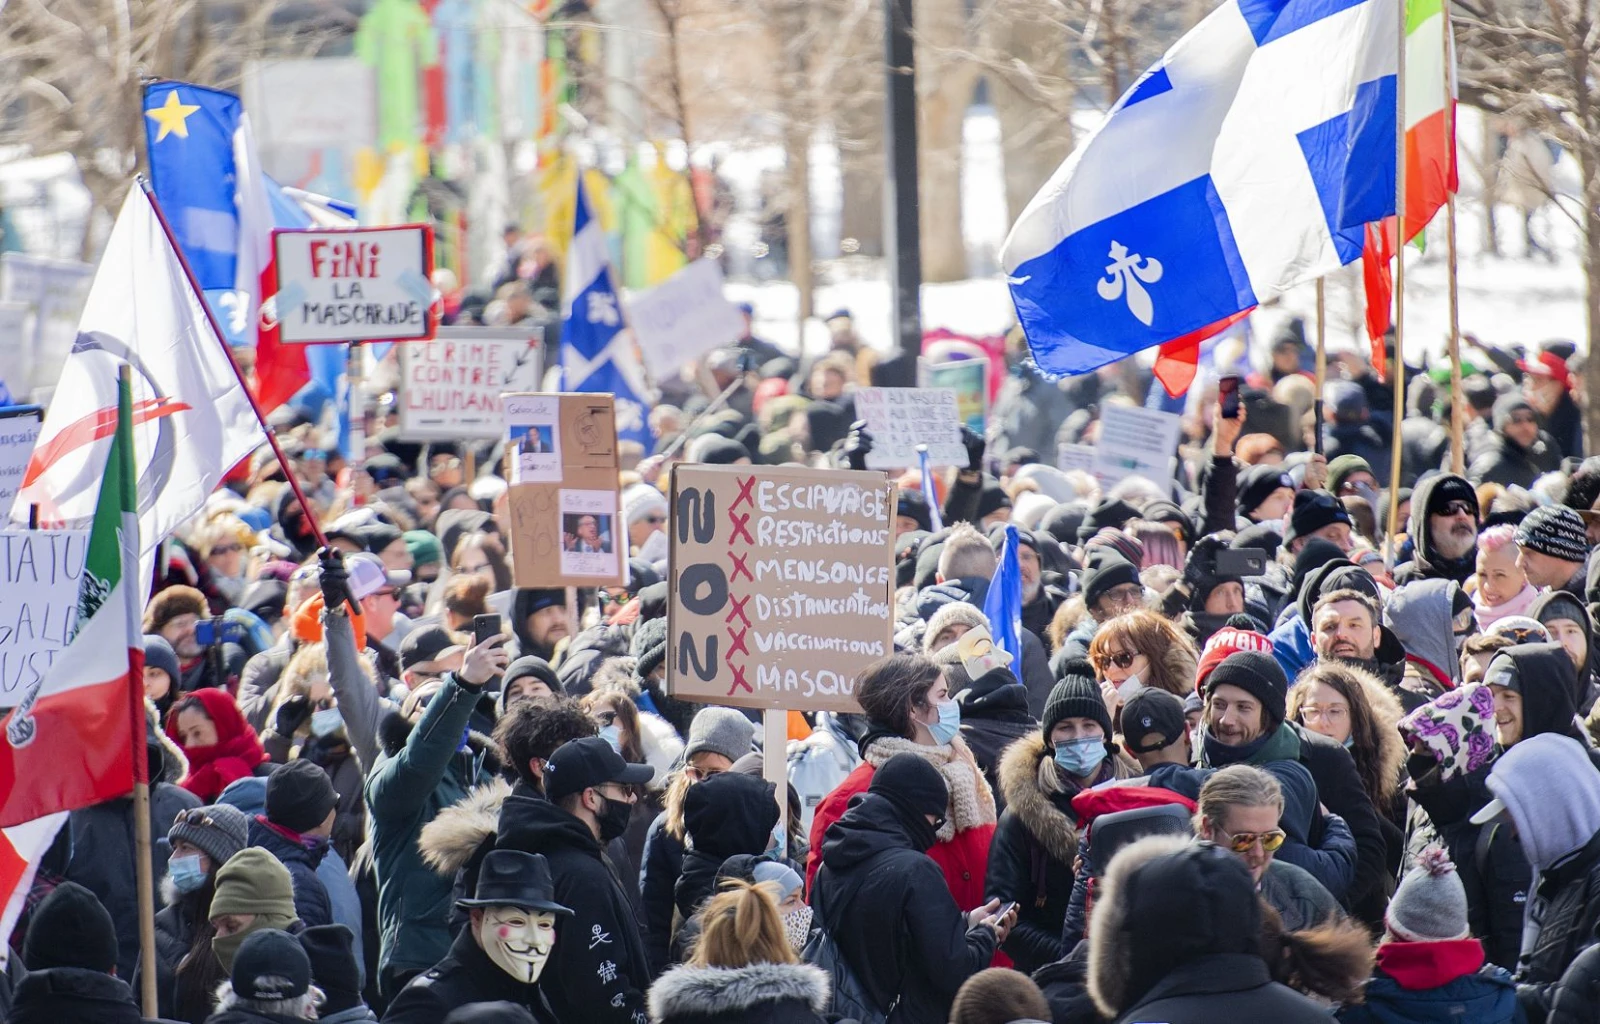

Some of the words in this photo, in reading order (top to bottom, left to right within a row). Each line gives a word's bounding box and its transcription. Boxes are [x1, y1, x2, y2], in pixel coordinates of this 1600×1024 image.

[333, 282, 363, 300] LA
[303, 301, 422, 326] MASCARADE
[413, 364, 500, 387] CONTRE
